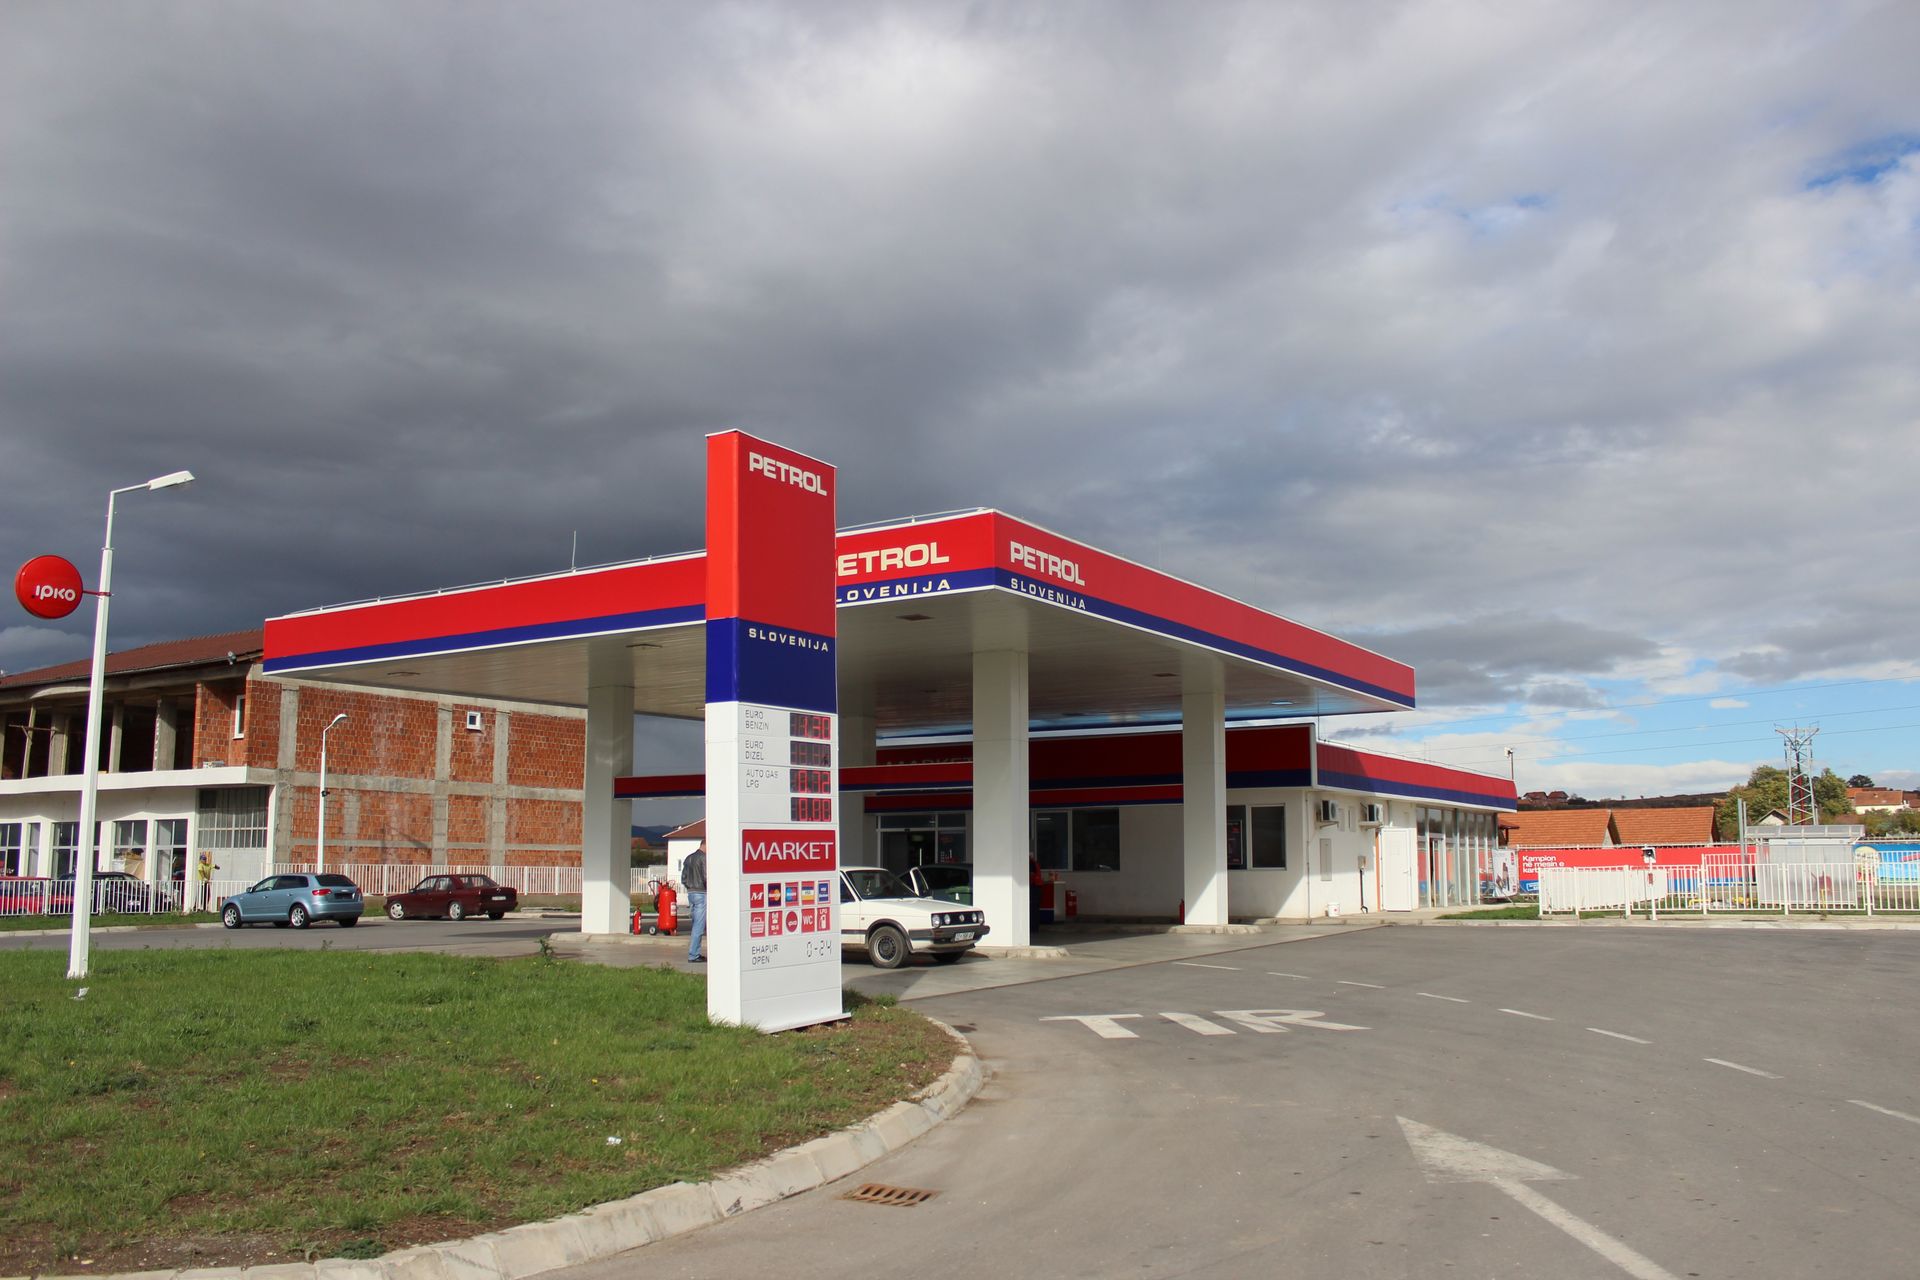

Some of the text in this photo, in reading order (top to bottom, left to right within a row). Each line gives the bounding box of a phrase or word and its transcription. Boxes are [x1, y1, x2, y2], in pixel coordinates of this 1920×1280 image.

[749, 451, 828, 497] PETROL
[836, 541, 950, 577] ETROL
[1010, 540, 1086, 587] PETROL
[836, 578, 951, 603] OVENIJA
[1010, 577, 1087, 610] SLOVENIJA
[748, 627, 830, 653] SLOVENIJA
[745, 710, 764, 720] EURO
[745, 720, 769, 731] BENZIN
[745, 740, 764, 749] EURO
[745, 751, 765, 761] DIZEL
[746, 769, 779, 779] AUTO GAS
[746, 780, 760, 788] LPG
[744, 841, 834, 861] MARKET
[803, 916, 813, 925] WC
[751, 939, 832, 958] EHAPUR 0-24
[751, 956, 770, 965] OPEN
[1038, 1009, 1374, 1039] TIR
